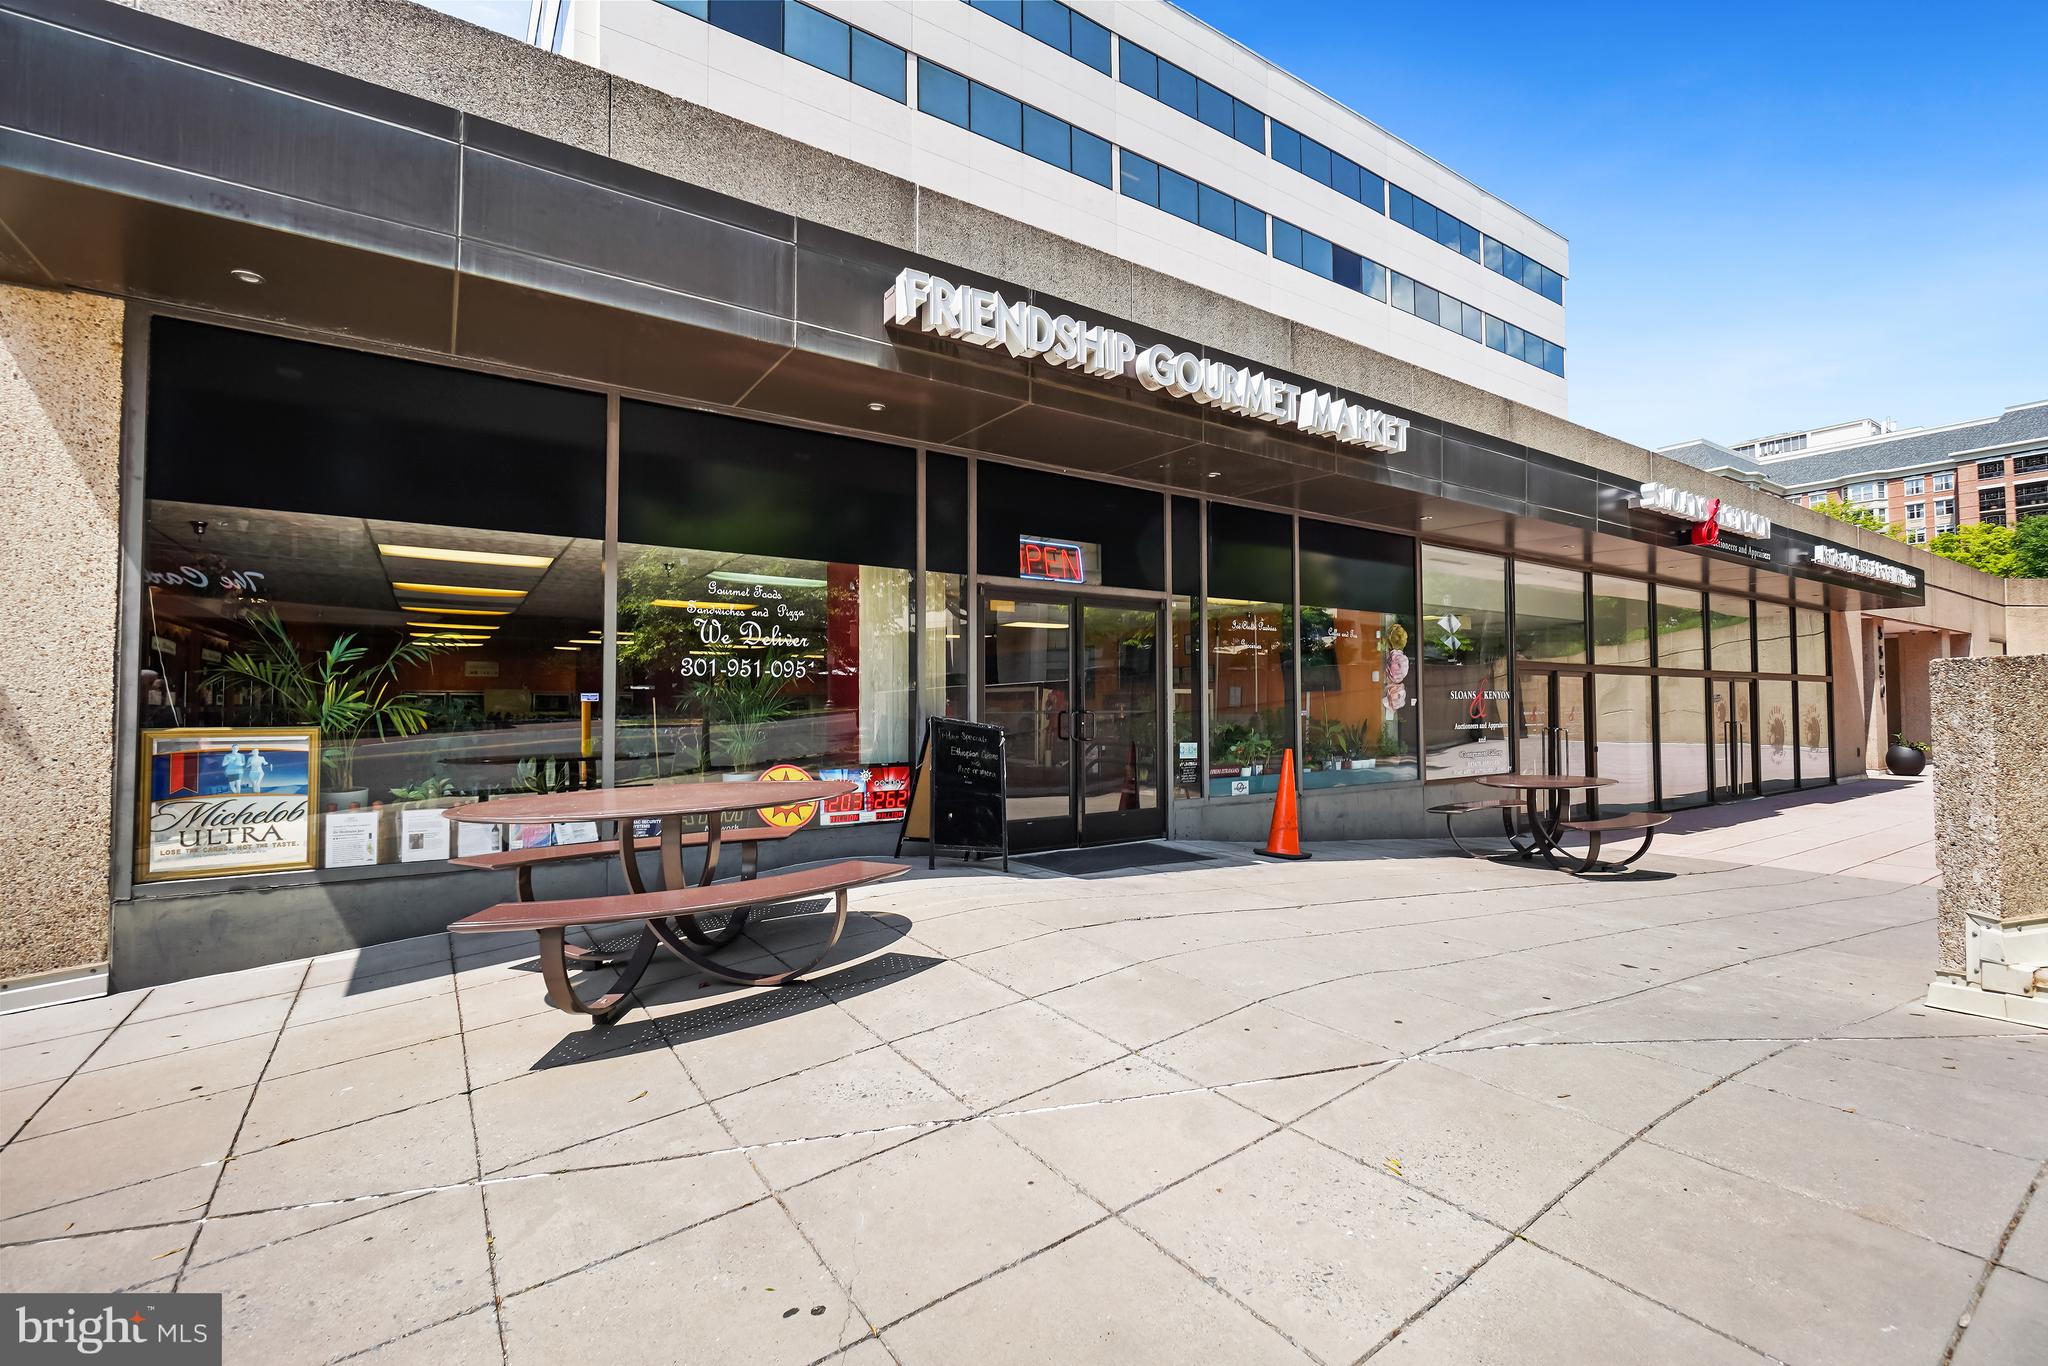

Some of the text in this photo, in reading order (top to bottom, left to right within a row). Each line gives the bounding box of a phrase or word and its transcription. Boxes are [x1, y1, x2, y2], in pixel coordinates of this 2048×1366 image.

[886, 267, 1410, 454] FRIENDSHIP GOURMET MARKET
[1020, 544, 1080, 580] PEN
[708, 580, 782, 600] Gourmet Foods
[686, 600, 805, 621] Sandwiches and Pizza
[693, 618, 810, 647] We Deliver
[1450, 690, 1477, 700] SLOANS
[1484, 690, 1510, 700] KENYON
[1479, 722, 1487, 730] and
[828, 790, 907, 812] 203 262
[150, 799, 309, 833] Michelob
[179, 824, 284, 848] ULTRA
